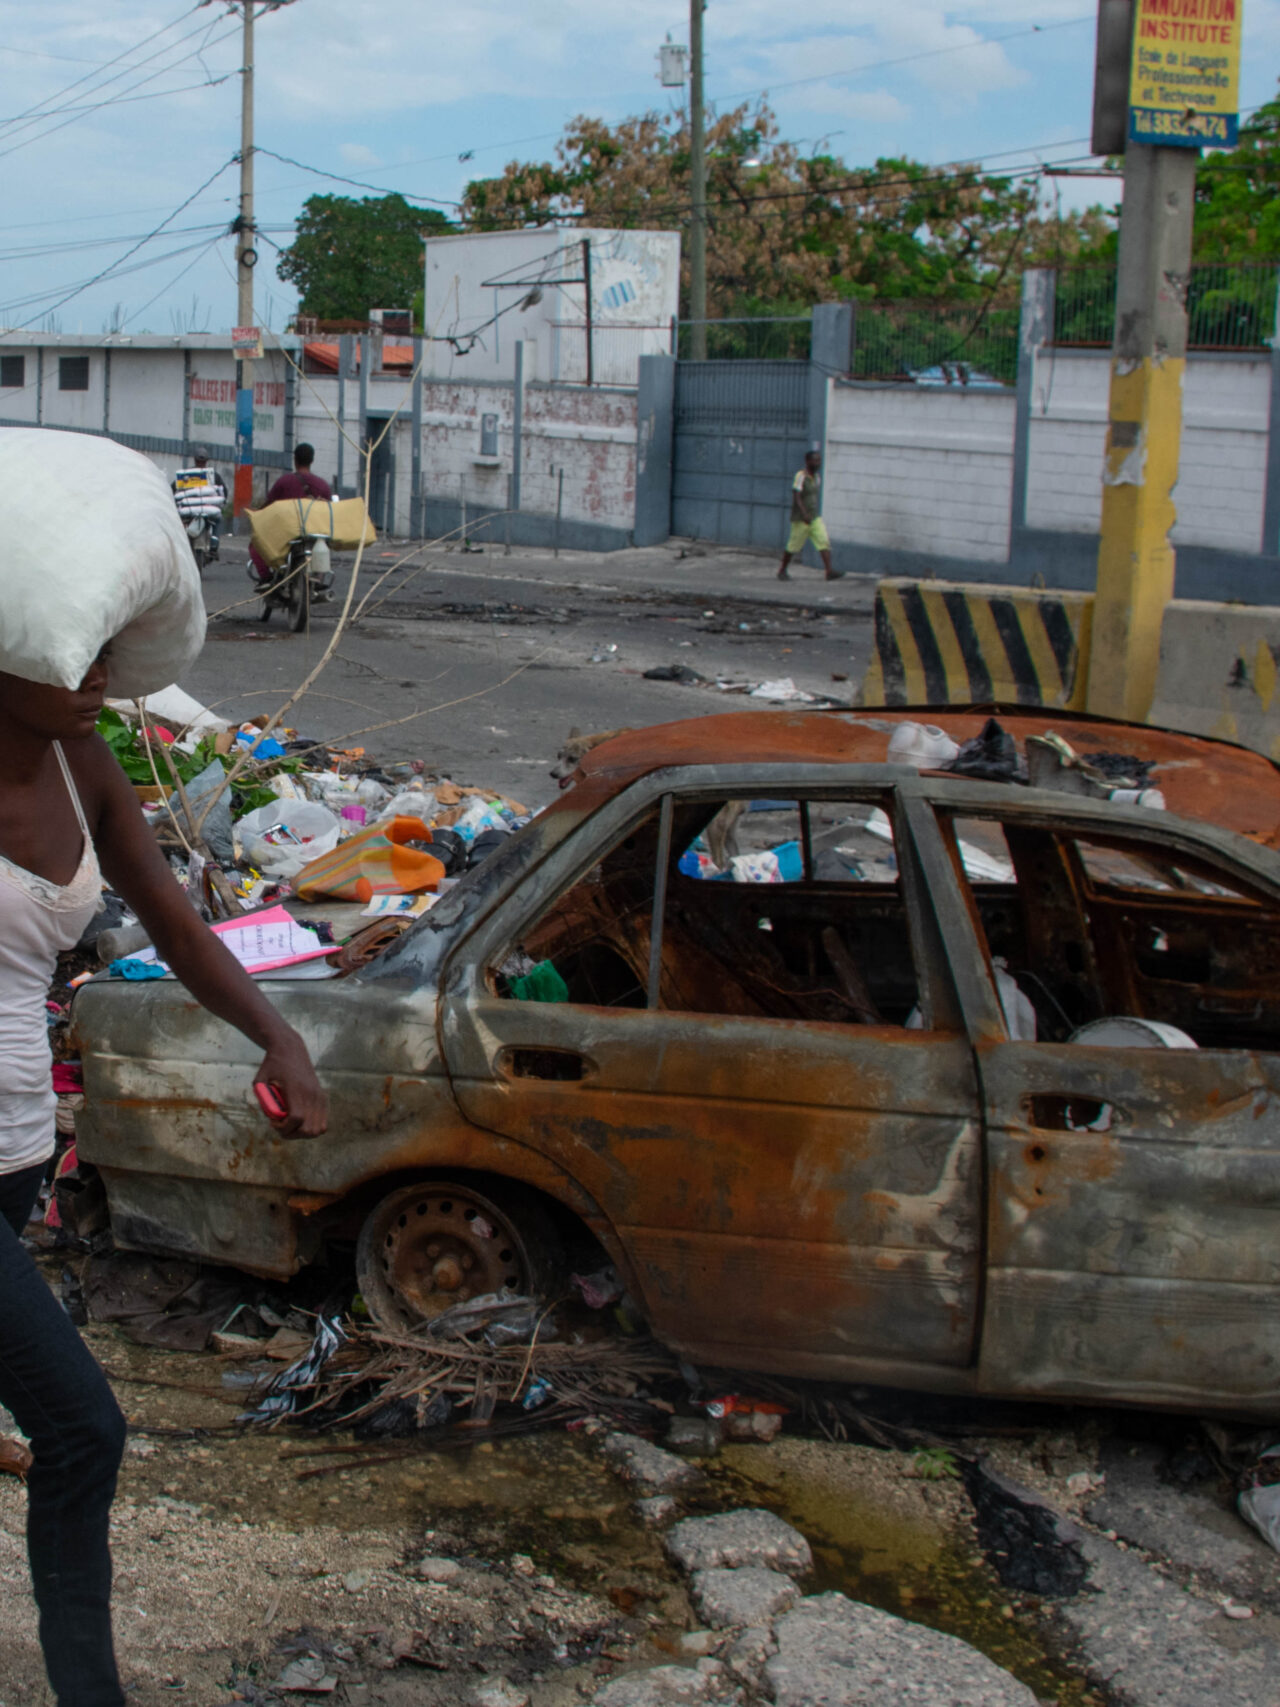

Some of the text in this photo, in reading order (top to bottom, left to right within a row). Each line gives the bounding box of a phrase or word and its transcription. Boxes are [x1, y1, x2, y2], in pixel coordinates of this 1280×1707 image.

[1140, 18, 1232, 44] INSTITUTE
[1166, 51, 1178, 66] de
[1158, 86, 1216, 106] Technique
